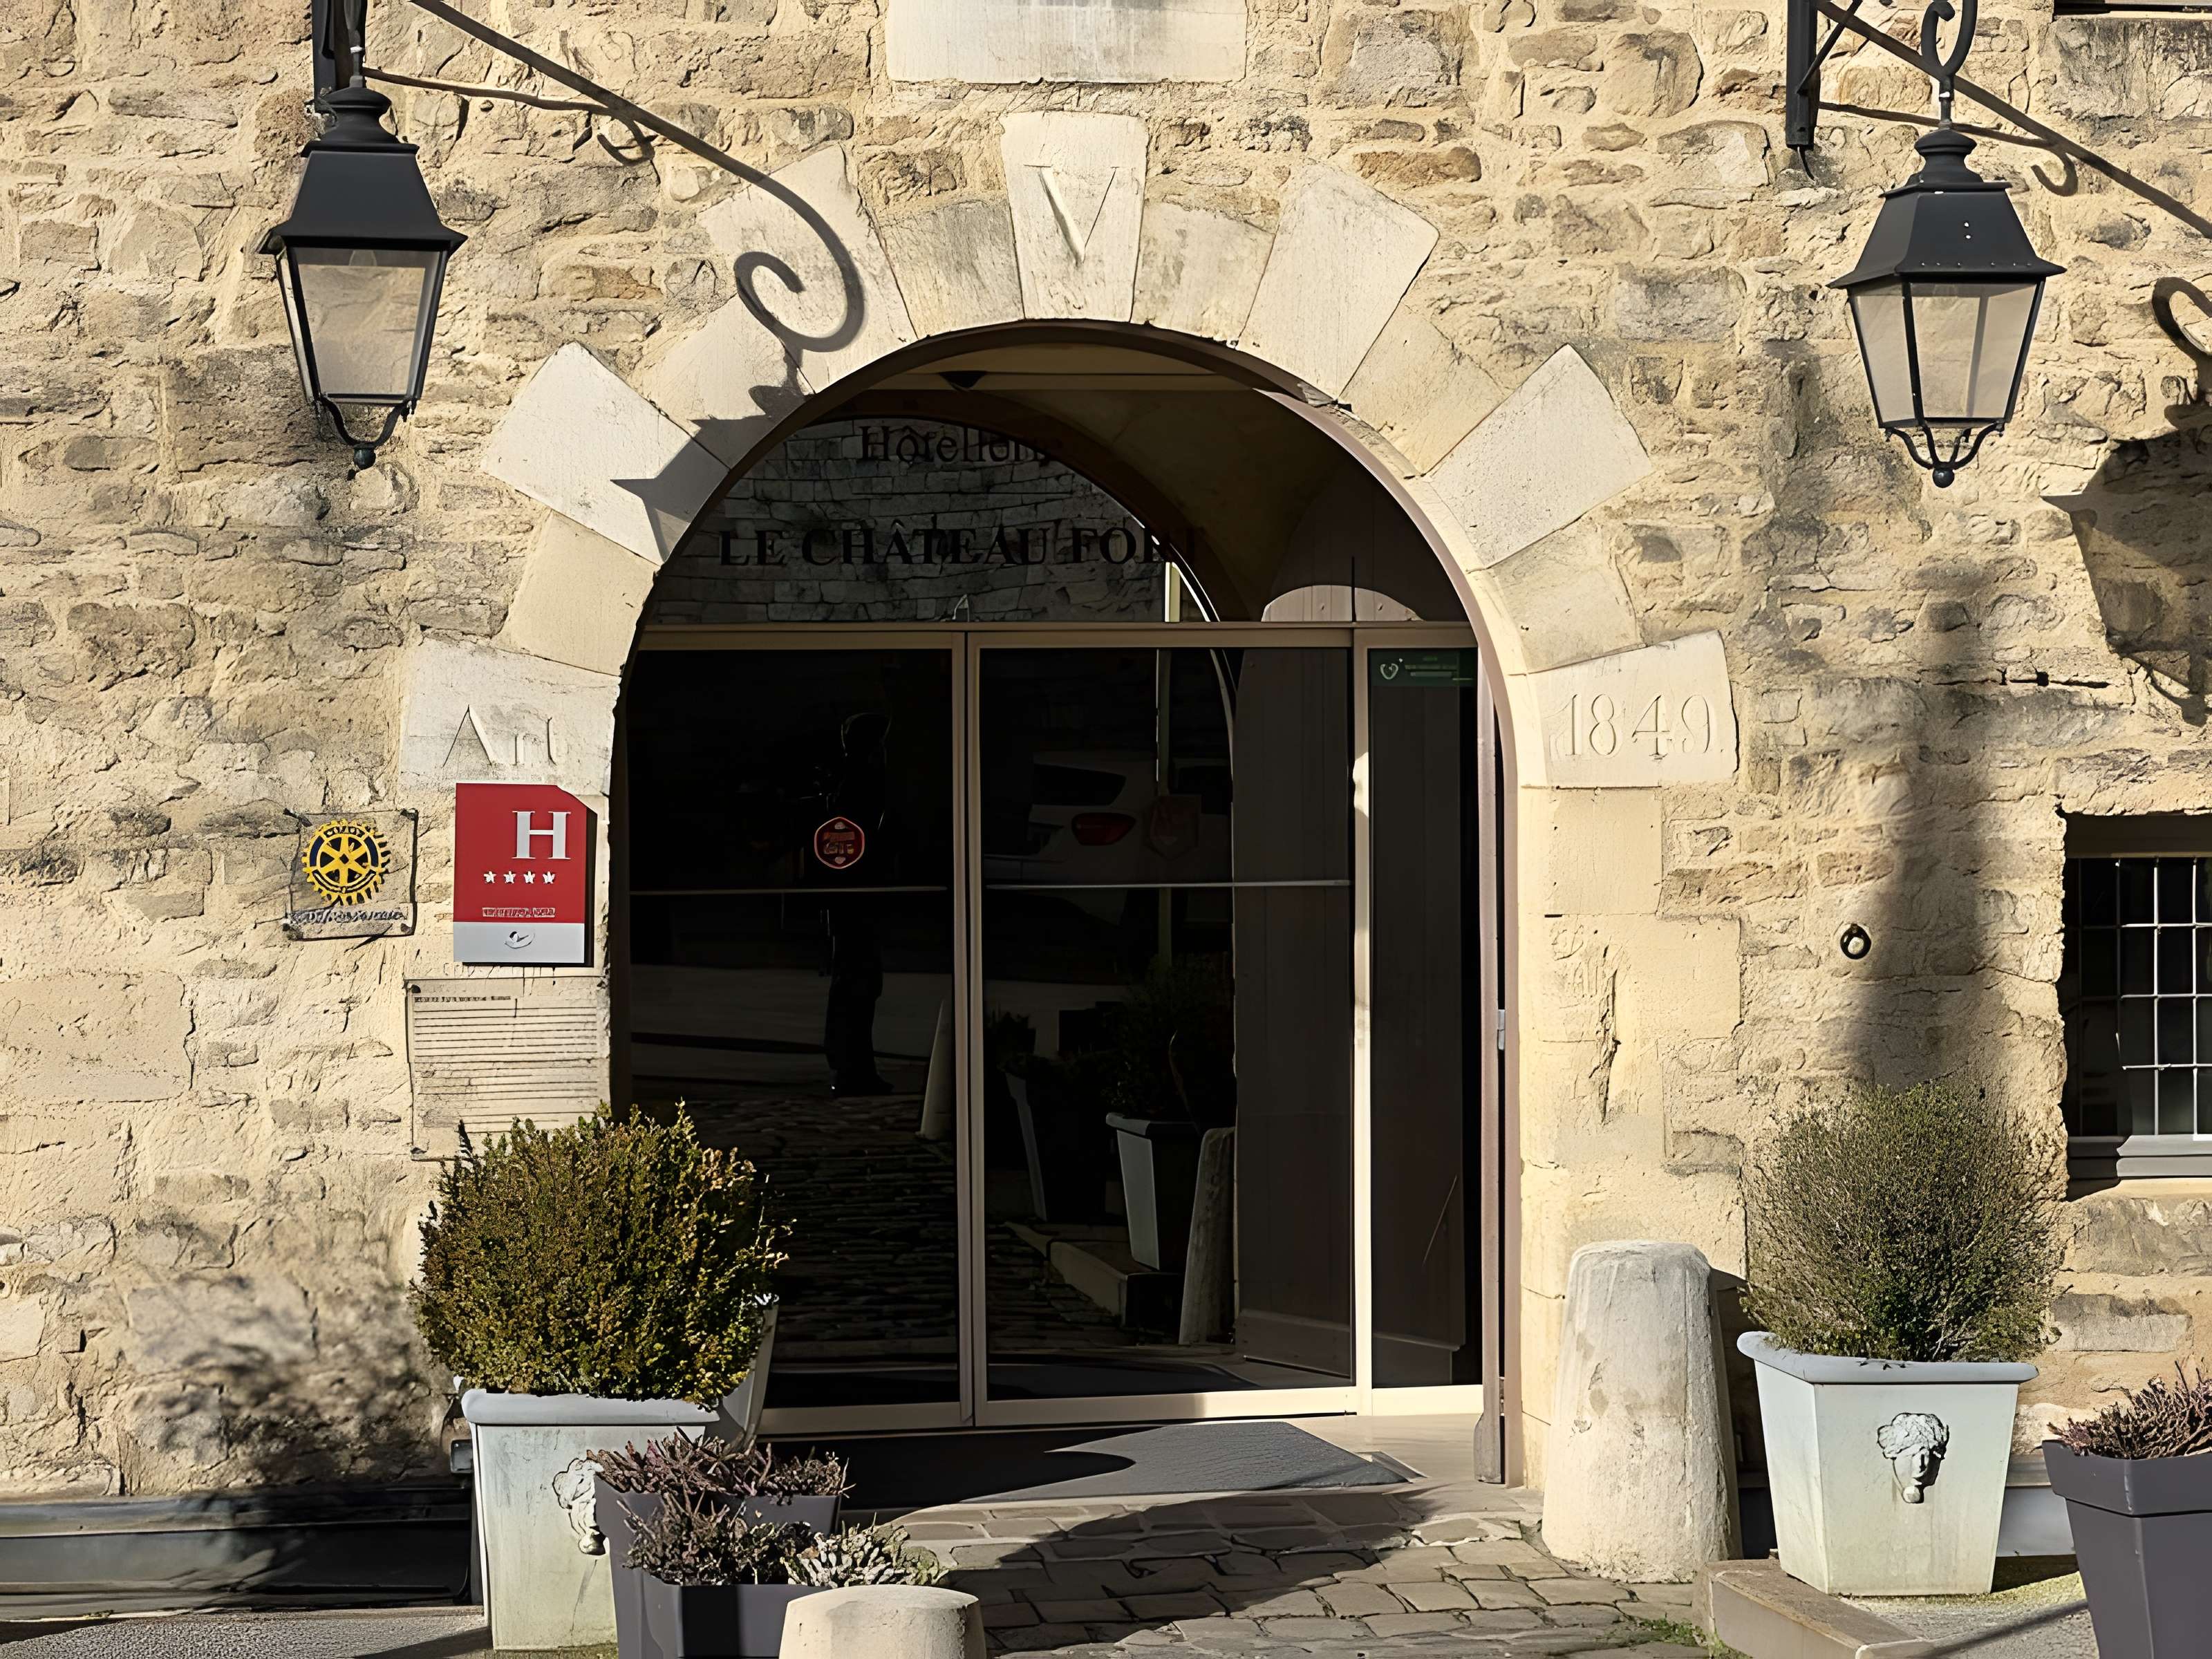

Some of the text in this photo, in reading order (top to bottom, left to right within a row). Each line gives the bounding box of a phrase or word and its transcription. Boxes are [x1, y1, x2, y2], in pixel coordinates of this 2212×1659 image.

[1023, 164, 1135, 267] V
[718, 529, 786, 565] LE
[800, 520, 1051, 565] CHÂTEAU
[1543, 693, 1717, 759] 1849
[512, 810, 572, 860] H
